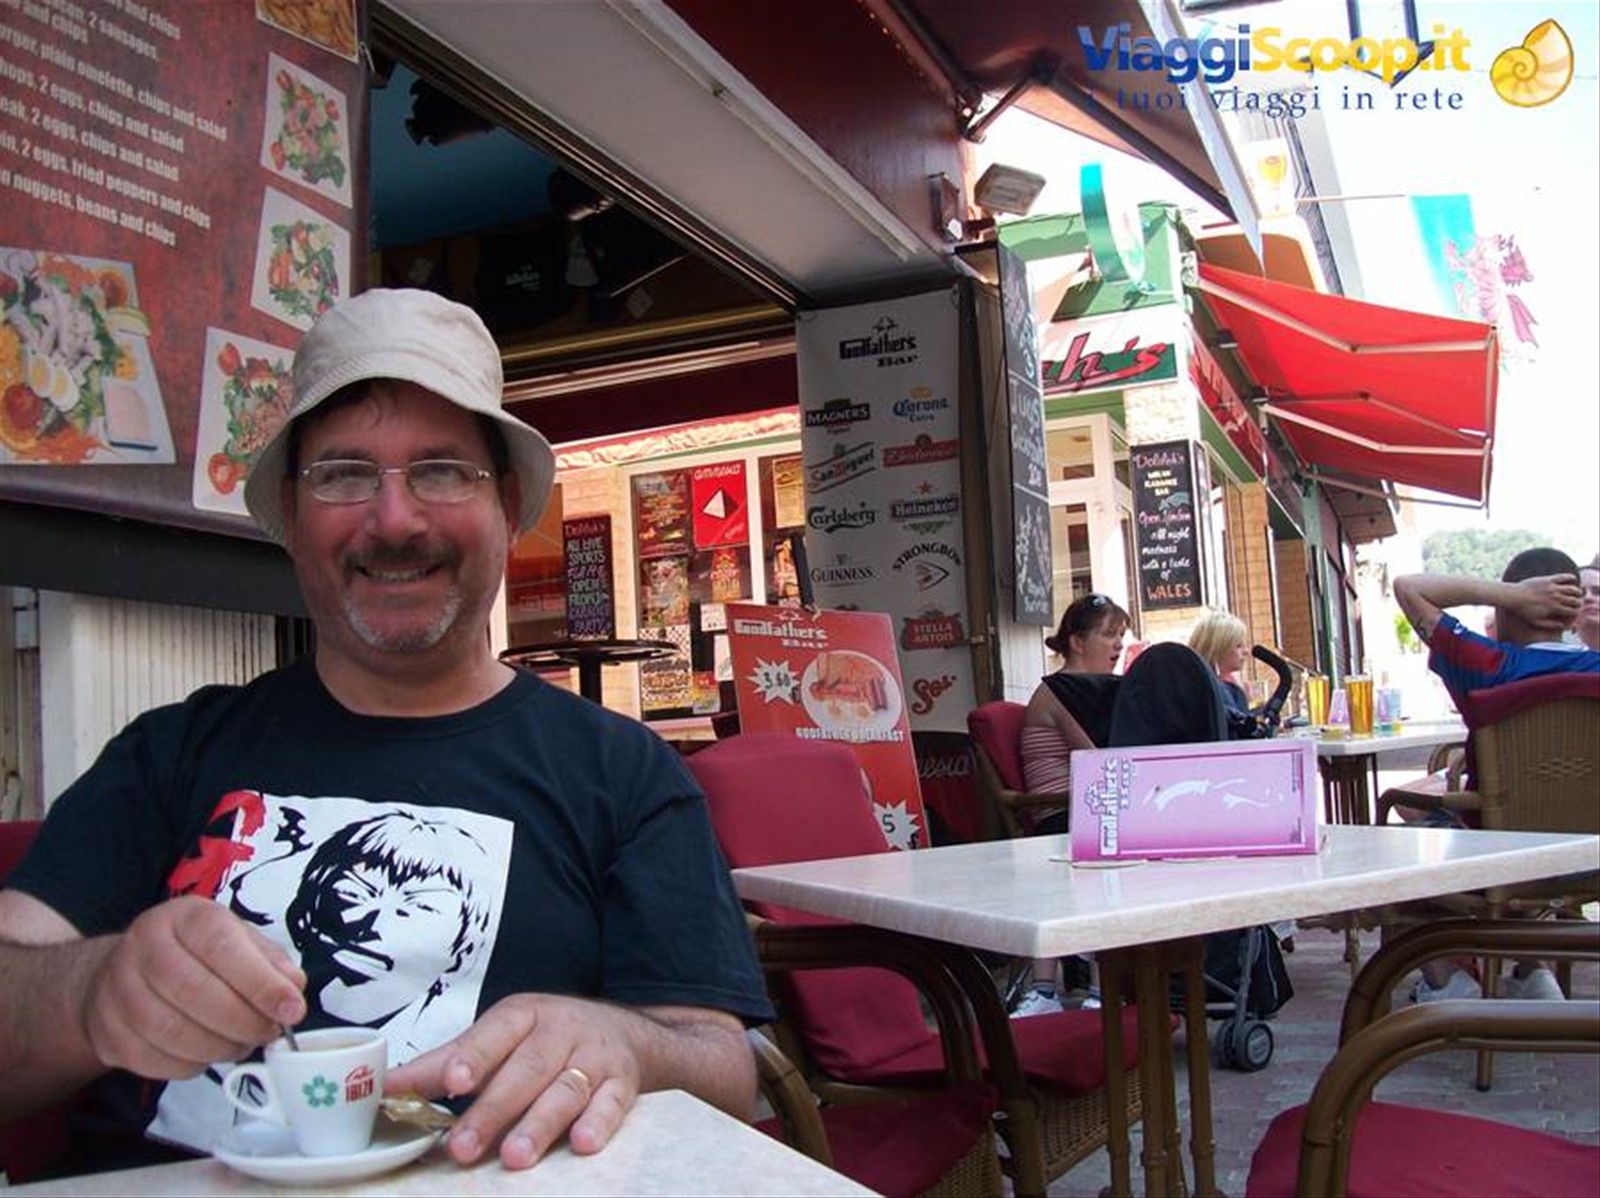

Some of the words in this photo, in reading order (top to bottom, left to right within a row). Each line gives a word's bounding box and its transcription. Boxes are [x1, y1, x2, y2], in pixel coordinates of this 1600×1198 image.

[40, 43, 76, 73] plain
[138, 88, 171, 116] chips
[172, 105, 195, 127] and
[196, 116, 228, 142] salad
[39, 75, 49, 94] 2
[88, 100, 123, 127] chips
[125, 115, 149, 139] and
[150, 127, 184, 154] salad
[31, 107, 41, 126] 2
[81, 131, 117, 158] chips
[119, 147, 143, 168] and
[145, 156, 179, 182] salad
[21, 137, 31, 158] 2
[72, 158, 104, 187] fried
[106, 173, 158, 207] peppers
[160, 195, 182, 216] and
[183, 204, 211, 230] chips
[76, 194, 118, 226] beans
[120, 212, 143, 234] and
[145, 220, 176, 247] chips
[806, 403, 870, 426] MAGNERS
[893, 398, 950, 417] Corona
[808, 501, 877, 532] Carlsberg
[892, 541, 961, 572] STRONGBOW
[811, 567, 875, 583] GUINNESS
[1147, 583, 1192, 600] WALES
[914, 623, 953, 634] STELLA
[914, 633, 954, 644] ARTOIS
